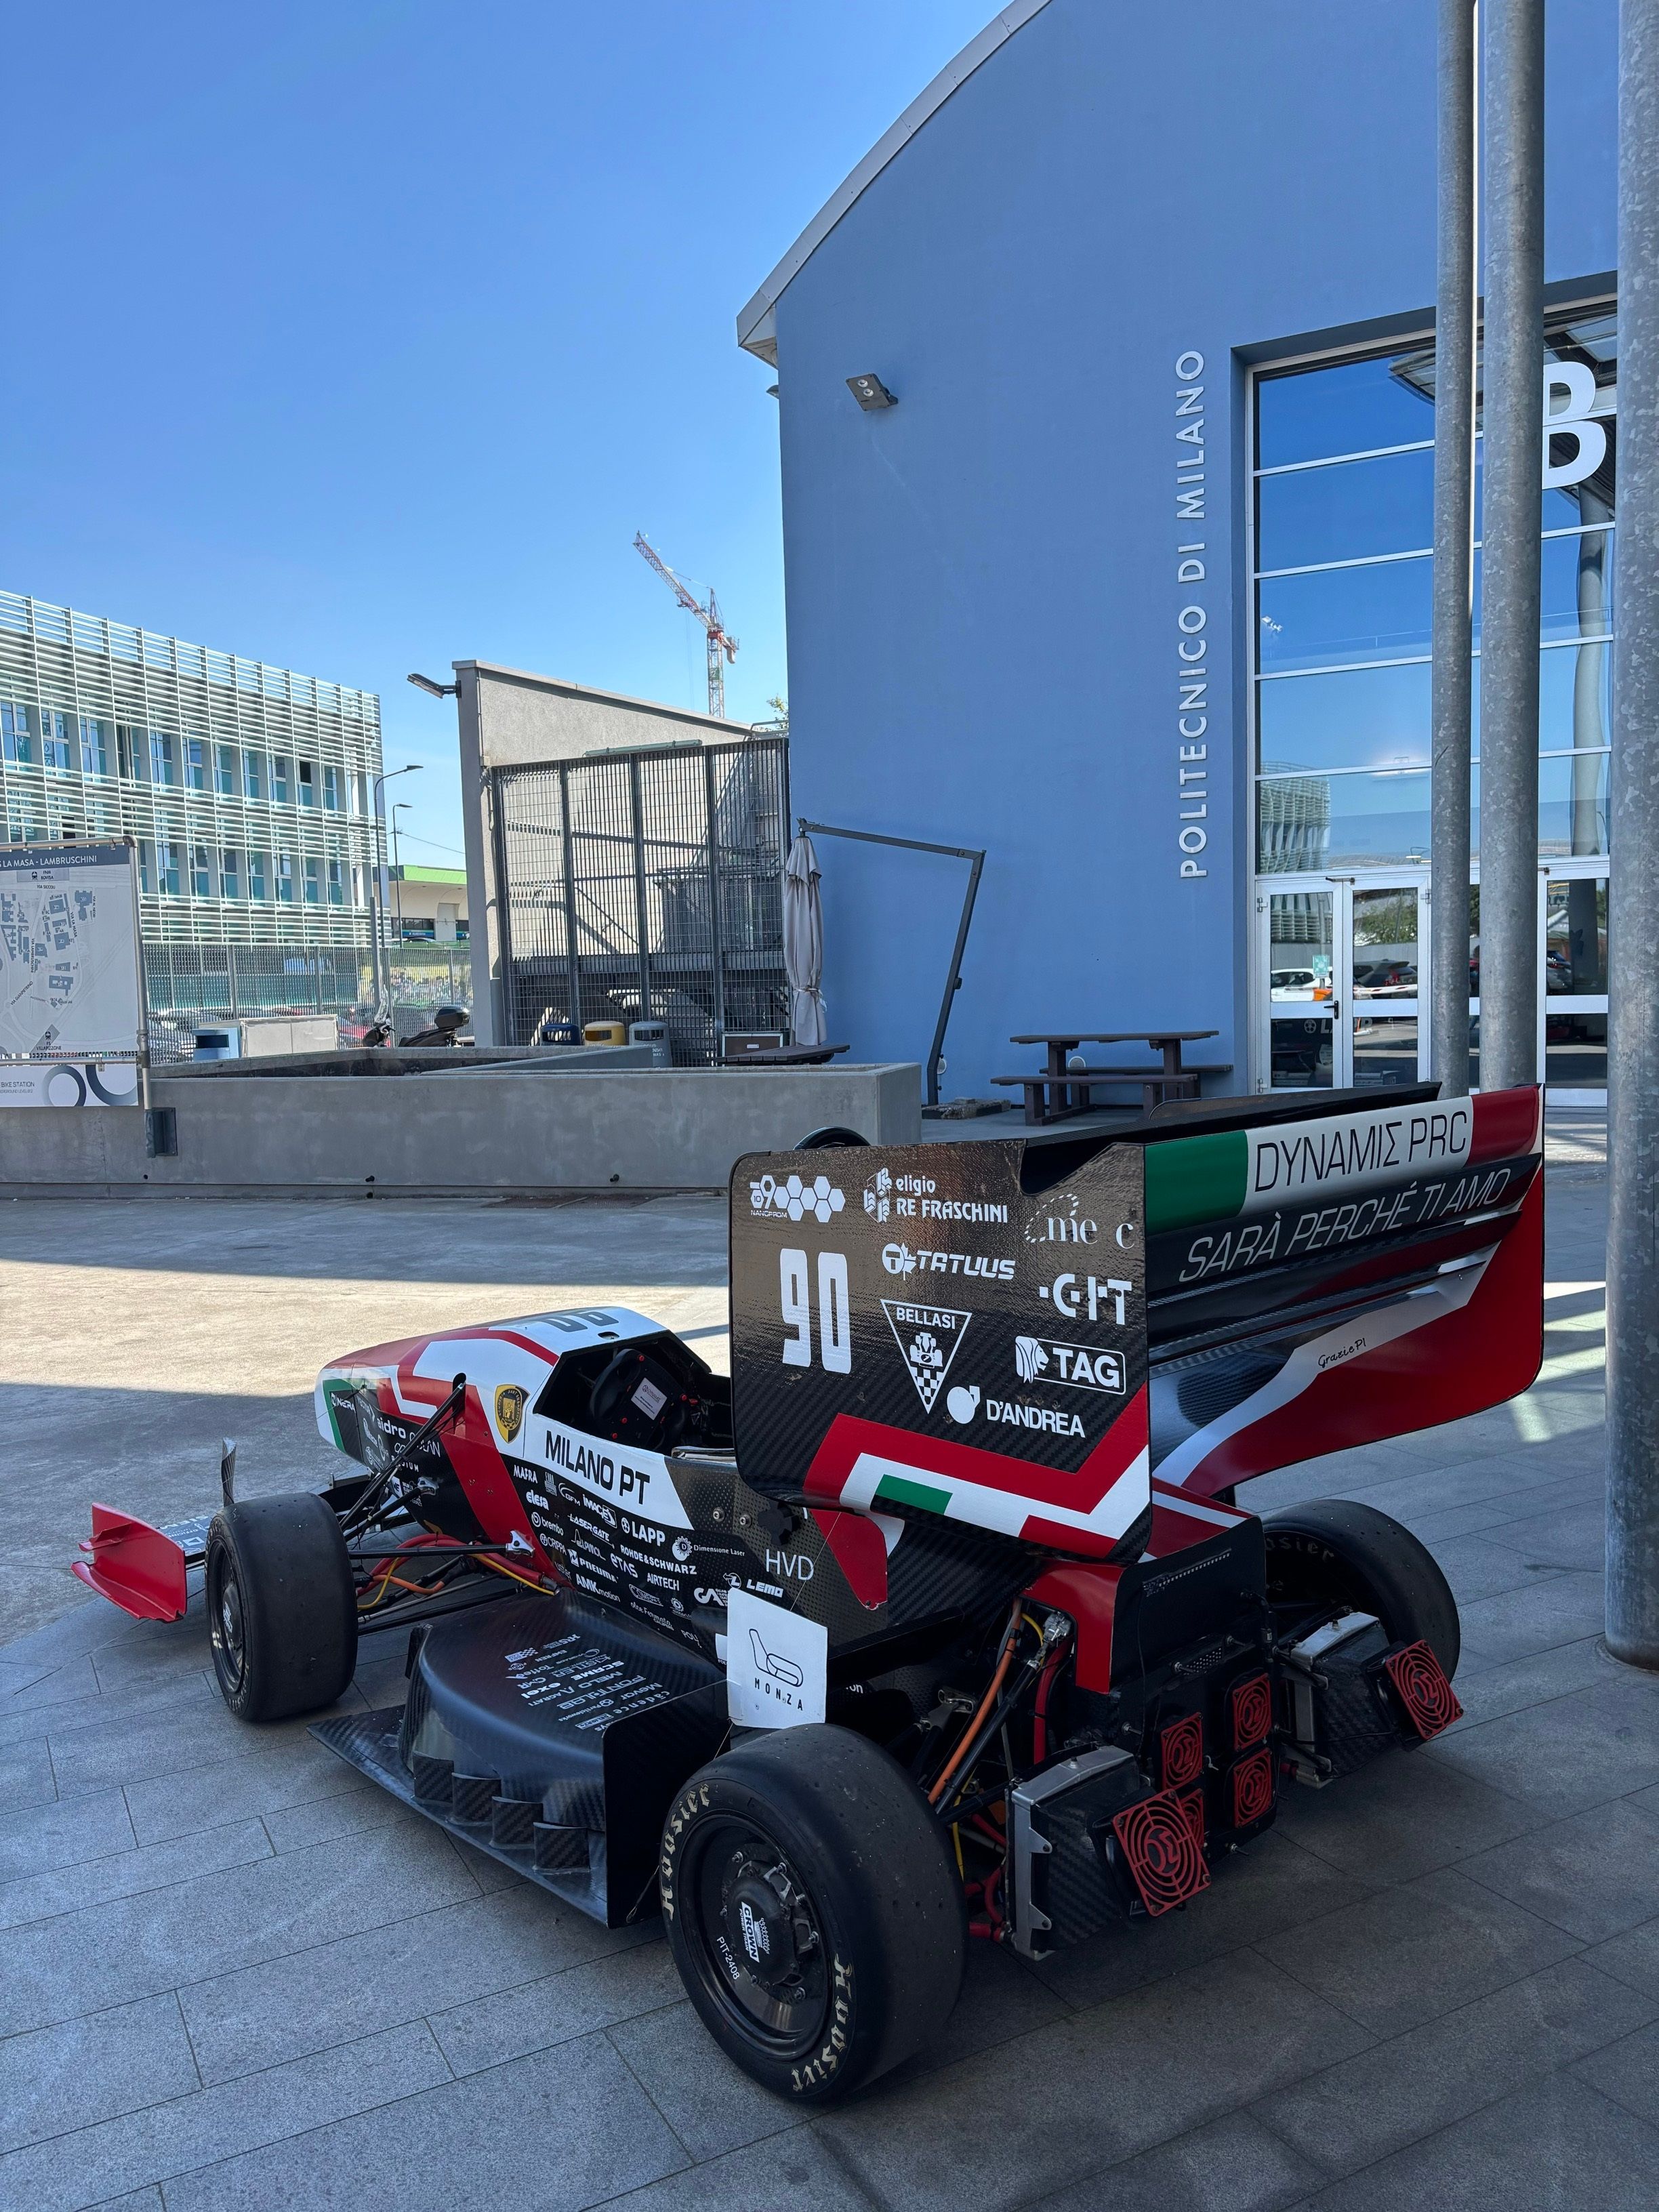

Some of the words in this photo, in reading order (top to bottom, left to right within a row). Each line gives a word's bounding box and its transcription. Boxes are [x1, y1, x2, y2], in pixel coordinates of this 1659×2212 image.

[1176, 350, 1206, 519] MILANO
[1542, 361, 1607, 490] B
[1178, 542, 1206, 583] DI
[1179, 605, 1208, 878] POLITECNICO
[14, 859, 34, 867] MASA
[40, 855, 97, 865] LAMBRUSCHINI
[1409, 1111, 1467, 1162] PRC
[896, 1175, 935, 1196] eligio
[897, 1198, 916, 1216] RE
[922, 1200, 1008, 1223] FRASCHINI
[1179, 1212, 1282, 1282] SARÀ
[1285, 1181, 1417, 1255] PERCHÉ
[1416, 1185, 1439, 1224] TI
[1439, 1168, 1511, 1218] AMO
[917, 1250, 1015, 1279] TATUUS
[780, 1248, 852, 1374] 90
[896, 1307, 956, 1330] BELLASI
[1318, 1345, 1355, 1368] Grazie
[1052, 1349, 1120, 1389] TAG
[377, 1417, 407, 1439] aidro
[986, 1399, 1086, 1438] D'ANDREA
[514, 1465, 538, 1483] MAFRA
[545, 1430, 614, 1491] MILANO
[619, 1472, 650, 1505] PT
[526, 1490, 550, 1511] elesa
[541, 1516, 564, 1536] brembo
[632, 1521, 665, 1547] LAPP
[548, 1536, 567, 1555] CRIPPA
[693, 1544, 729, 1555] Dimensione
[731, 1549, 745, 1557] Laser
[620, 1544, 697, 1575] ROHDE&SCHWARZ
[766, 1549, 814, 1581] HVD
[647, 1572, 680, 1591] AIRTECH
[746, 1579, 784, 1598] LEMO
[552, 1656, 611, 1678] KISTLER
[571, 1660, 625, 1681] SCAME
[521, 1682, 561, 1699] exel
[578, 1671, 623, 1689] MELO
[621, 1683, 663, 1700] Mevar
[528, 1692, 562, 1707] AGRATI
[754, 1677, 803, 1711] MONZA
[744, 1907, 758, 1959] CROWN
[716, 1936, 740, 1980] PIT-2408
